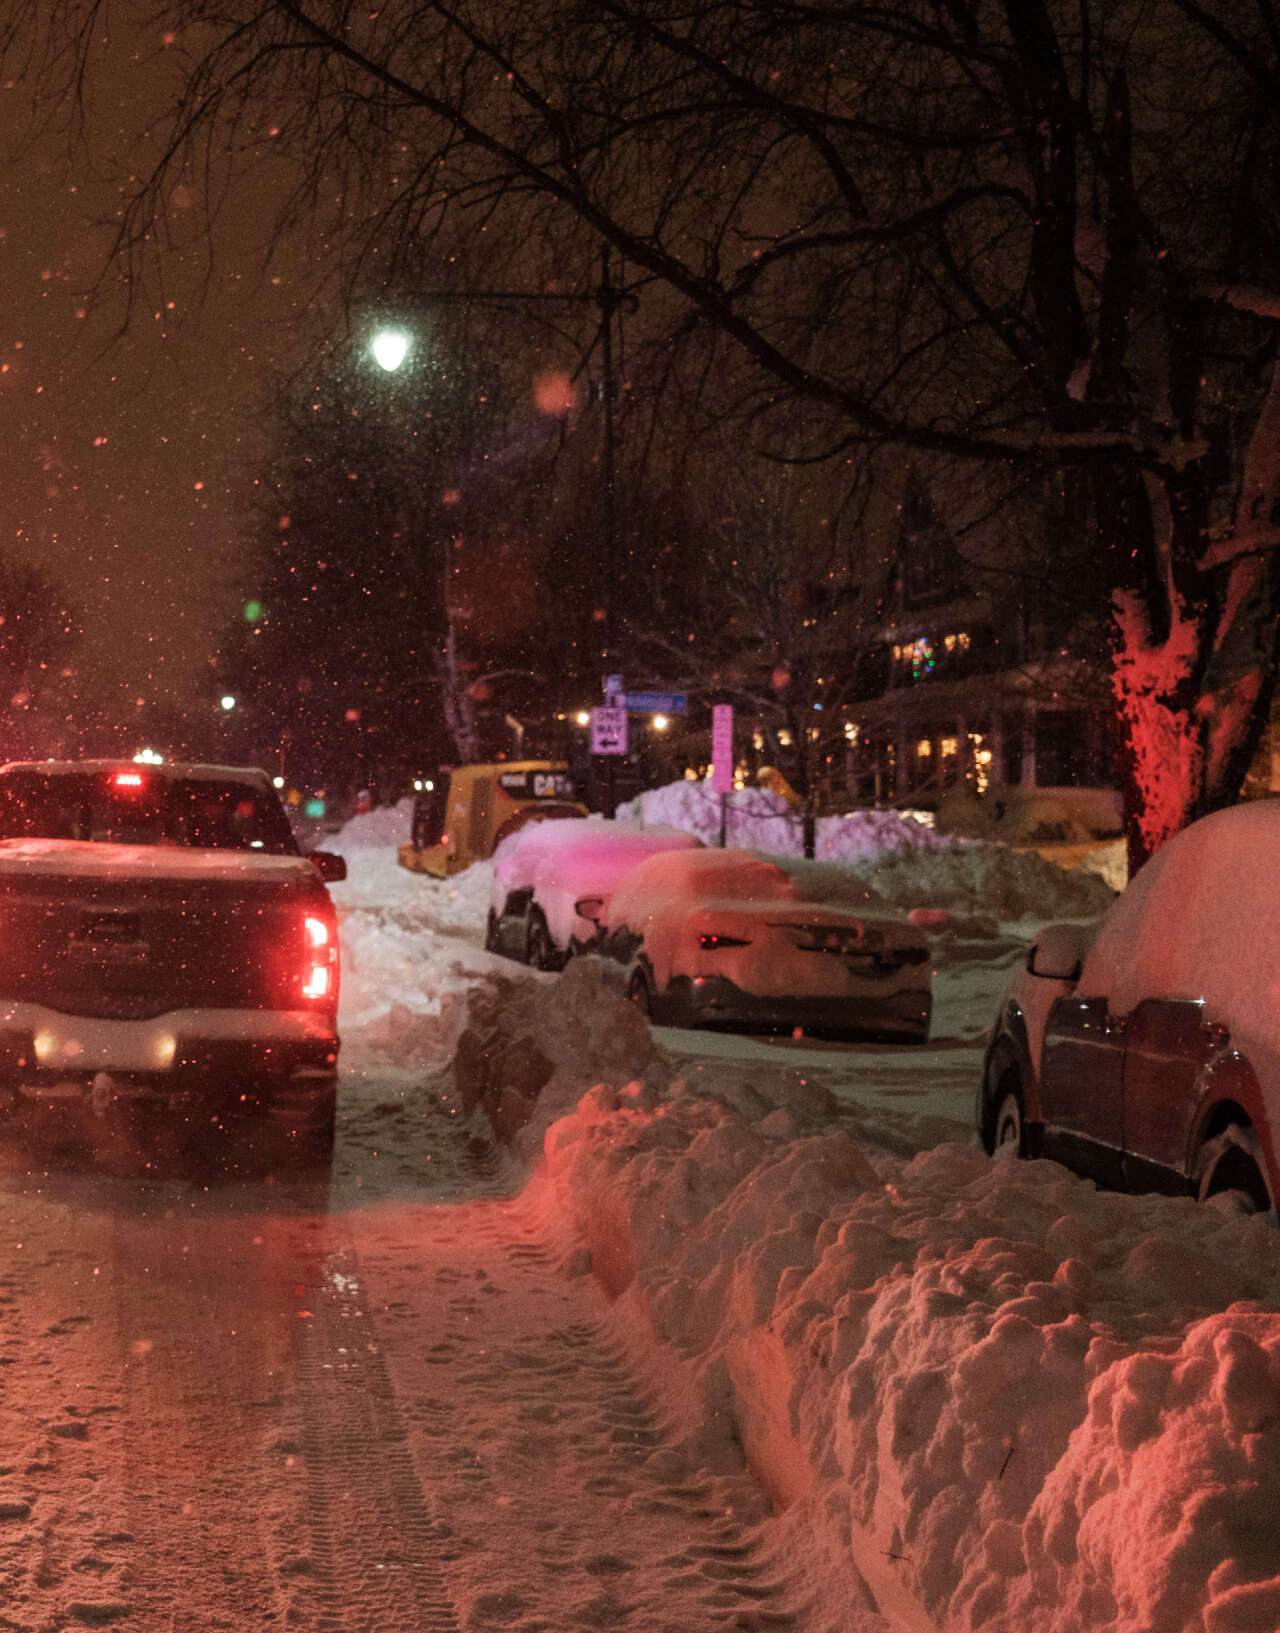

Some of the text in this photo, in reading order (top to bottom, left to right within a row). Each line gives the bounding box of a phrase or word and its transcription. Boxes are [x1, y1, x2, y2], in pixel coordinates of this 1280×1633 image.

[598, 711, 622, 723] ONE
[597, 724, 622, 735] WAY
[534, 774, 565, 797] CAT
